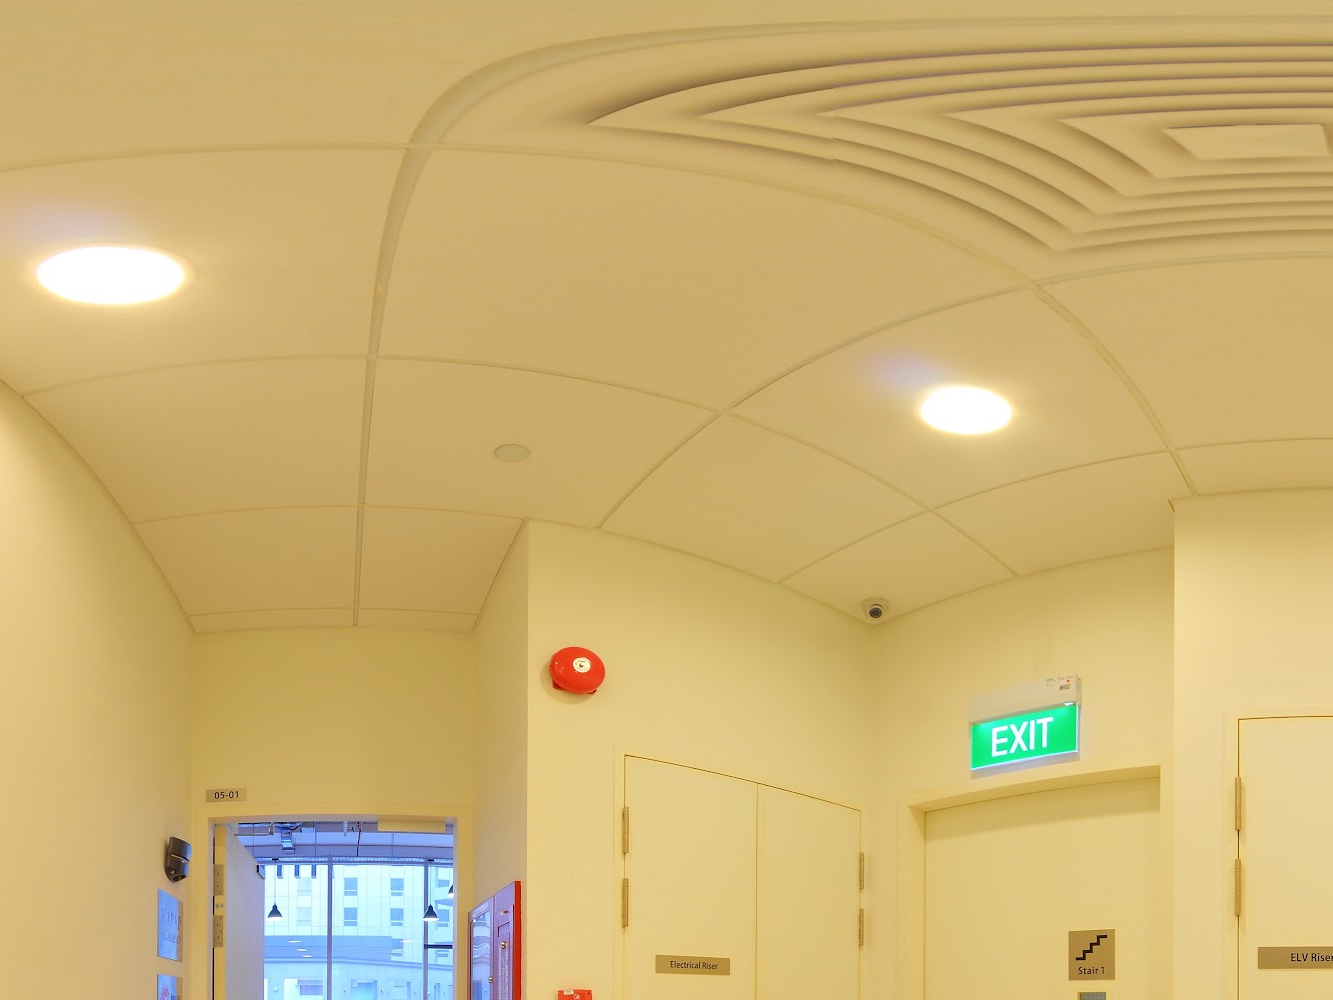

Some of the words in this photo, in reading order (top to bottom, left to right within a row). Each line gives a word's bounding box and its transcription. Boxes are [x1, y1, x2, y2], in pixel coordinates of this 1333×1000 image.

[991, 716, 1054, 757] EXIT
[214, 790, 239, 800] 05-01
[1290, 952, 1309, 962] ELV
[670, 960, 701, 969] Electrical
[702, 961, 718, 970] Riser
[1078, 966, 1099, 975] Stair
[1101, 966, 1105, 975] 1
